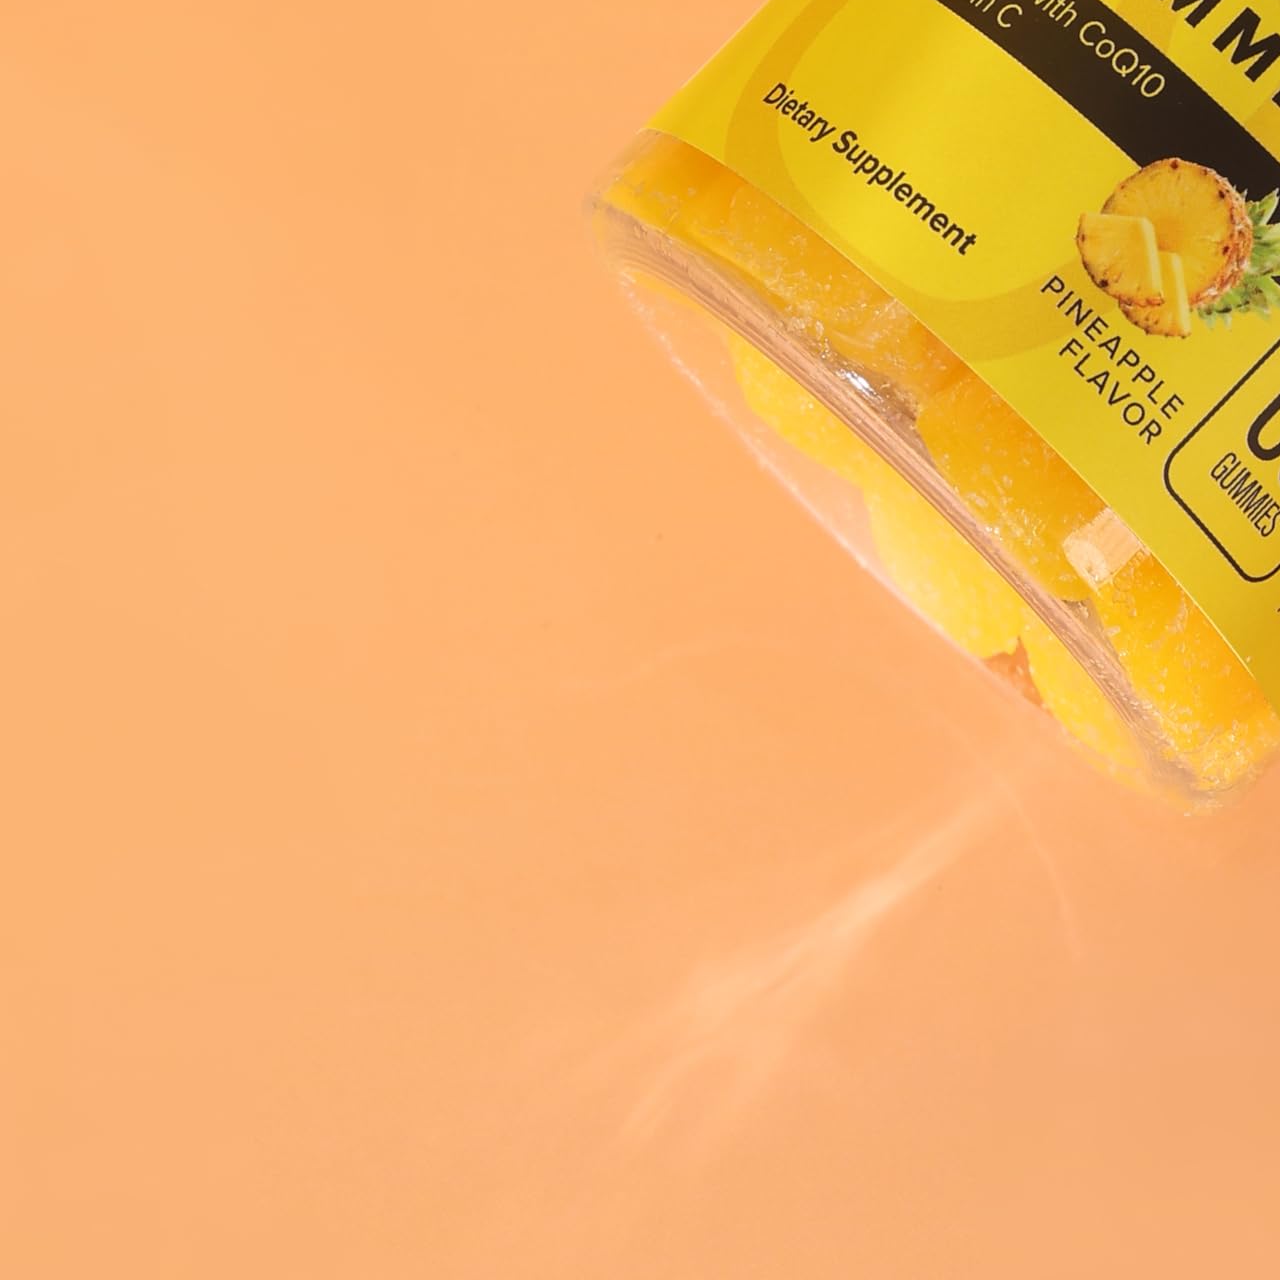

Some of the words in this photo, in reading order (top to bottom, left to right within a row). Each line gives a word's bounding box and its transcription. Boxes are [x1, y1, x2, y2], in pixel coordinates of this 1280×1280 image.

[996, 3, 1023, 28] C
[1079, 20, 1166, 98] CoQ10
[762, 82, 836, 143] Dietary
[831, 130, 977, 256] Supplement
[1040, 274, 1185, 420] PINEAPPLE
[1057, 338, 1163, 445] FLAVOR
